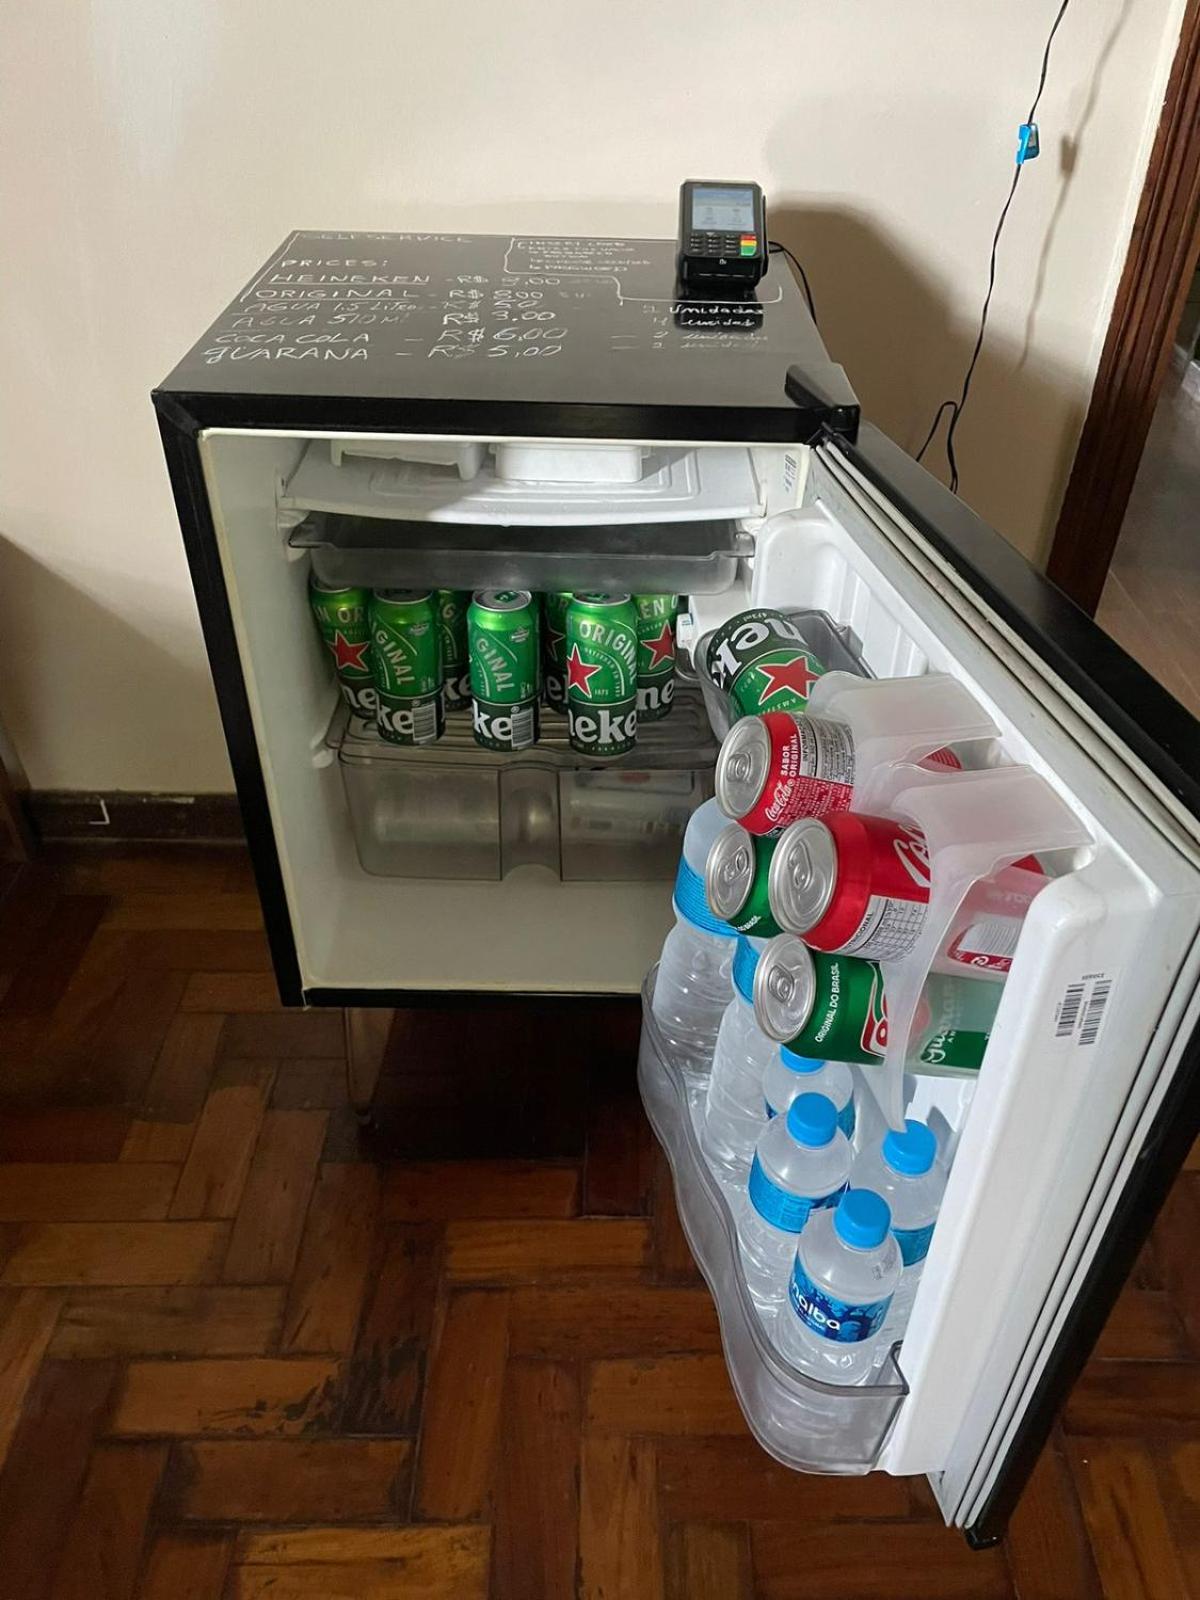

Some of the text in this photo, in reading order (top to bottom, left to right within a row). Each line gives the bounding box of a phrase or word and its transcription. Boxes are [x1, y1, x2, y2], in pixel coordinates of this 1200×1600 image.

[255, 289, 419, 298] ORIGINAL
[781, 745, 790, 775] SABOR
[788, 734, 798, 777] ORIGINAL
[815, 962, 841, 1043] ORIGINAL DO BRASIL
